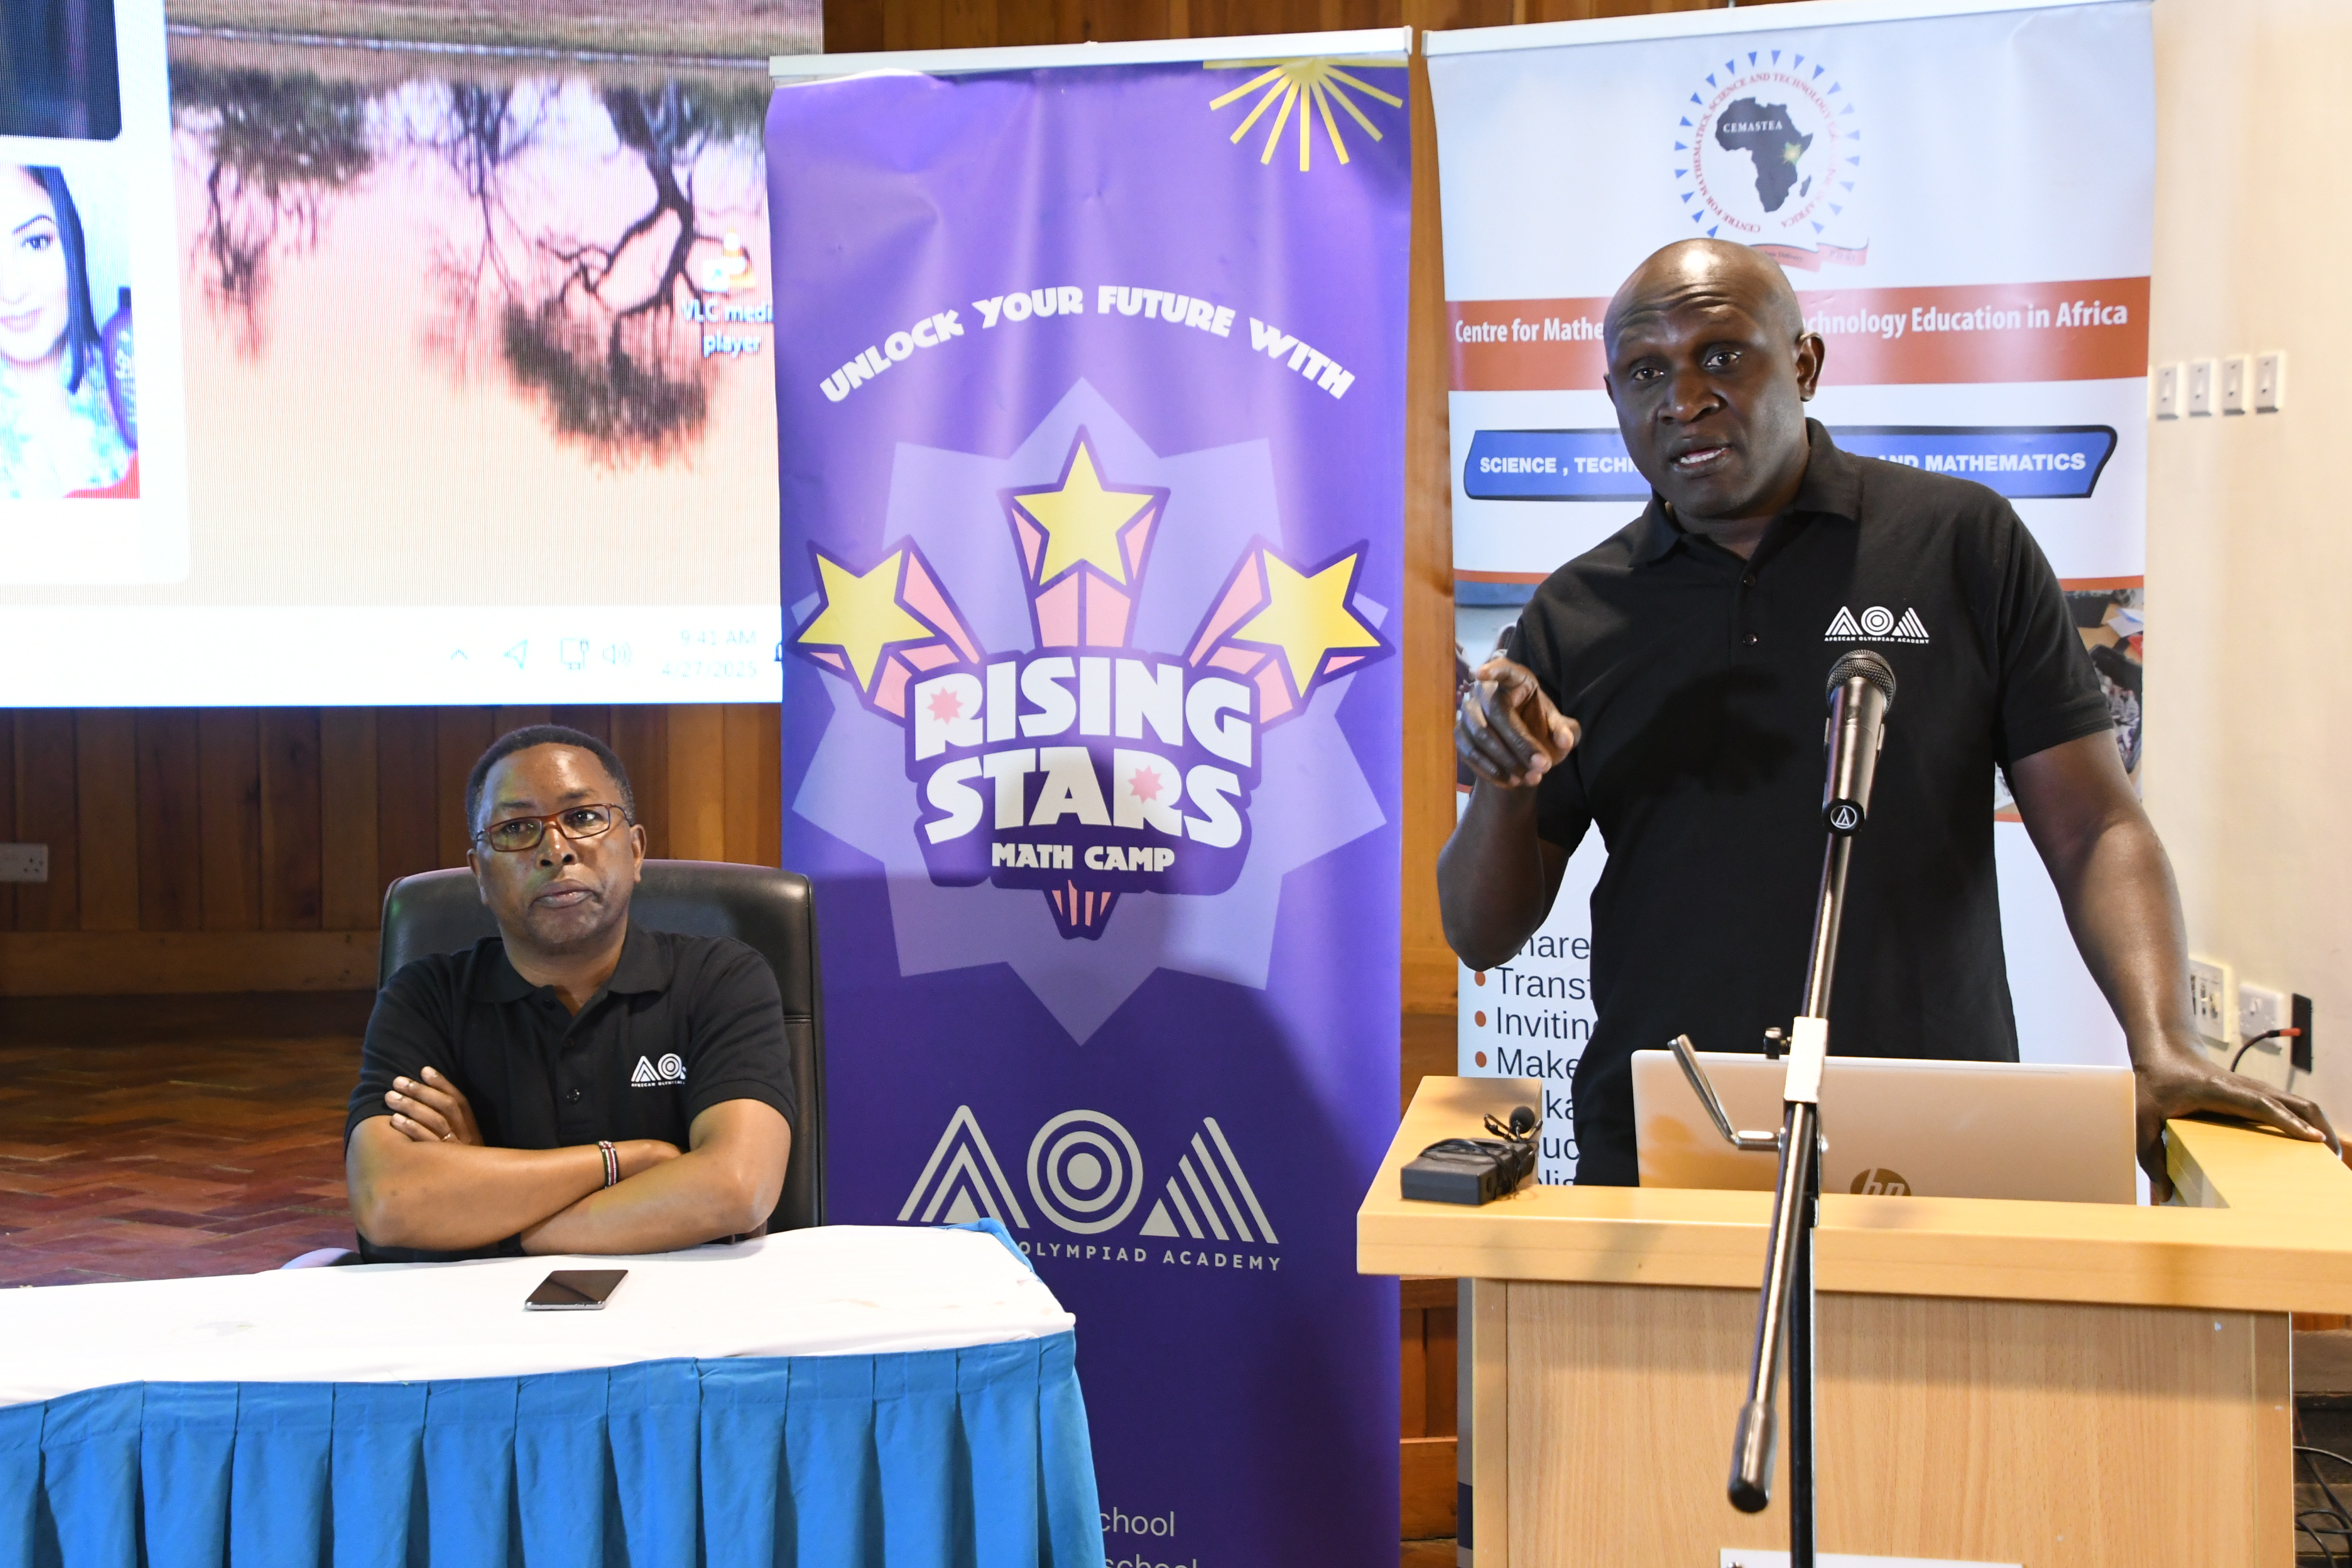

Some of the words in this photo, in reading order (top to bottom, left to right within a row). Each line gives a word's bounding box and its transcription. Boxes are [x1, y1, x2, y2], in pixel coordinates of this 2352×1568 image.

[1749, 73, 1770, 83] AND
[1723, 120, 1783, 133] CEMASTEA
[681, 299, 718, 323] VLC
[1802, 309, 1907, 339] chnology
[1912, 305, 2021, 332] Education
[2028, 304, 2050, 328] in
[2056, 300, 2128, 327] Africa
[703, 329, 760, 358] player
[819, 309, 964, 402] UNLOCK
[972, 286, 1083, 328] YOUR
[1098, 286, 1236, 337] FUTURE
[1249, 317, 1355, 399] WITH
[1455, 320, 1508, 342] Centre
[1511, 318, 1540, 342] for
[1480, 457, 1557, 473] SCIENCE
[1925, 453, 2086, 472] MATHEMATICS
[915, 657, 1251, 768] RISING
[924, 746, 1241, 848] STARS
[992, 843, 1073, 868] MATH
[1084, 846, 1175, 872] CAMP
[1495, 966, 1593, 1000] Trans
[1018, 1241, 1147, 1262] OLYMPIAD
[1162, 1250, 1280, 1271] ACADEMY
